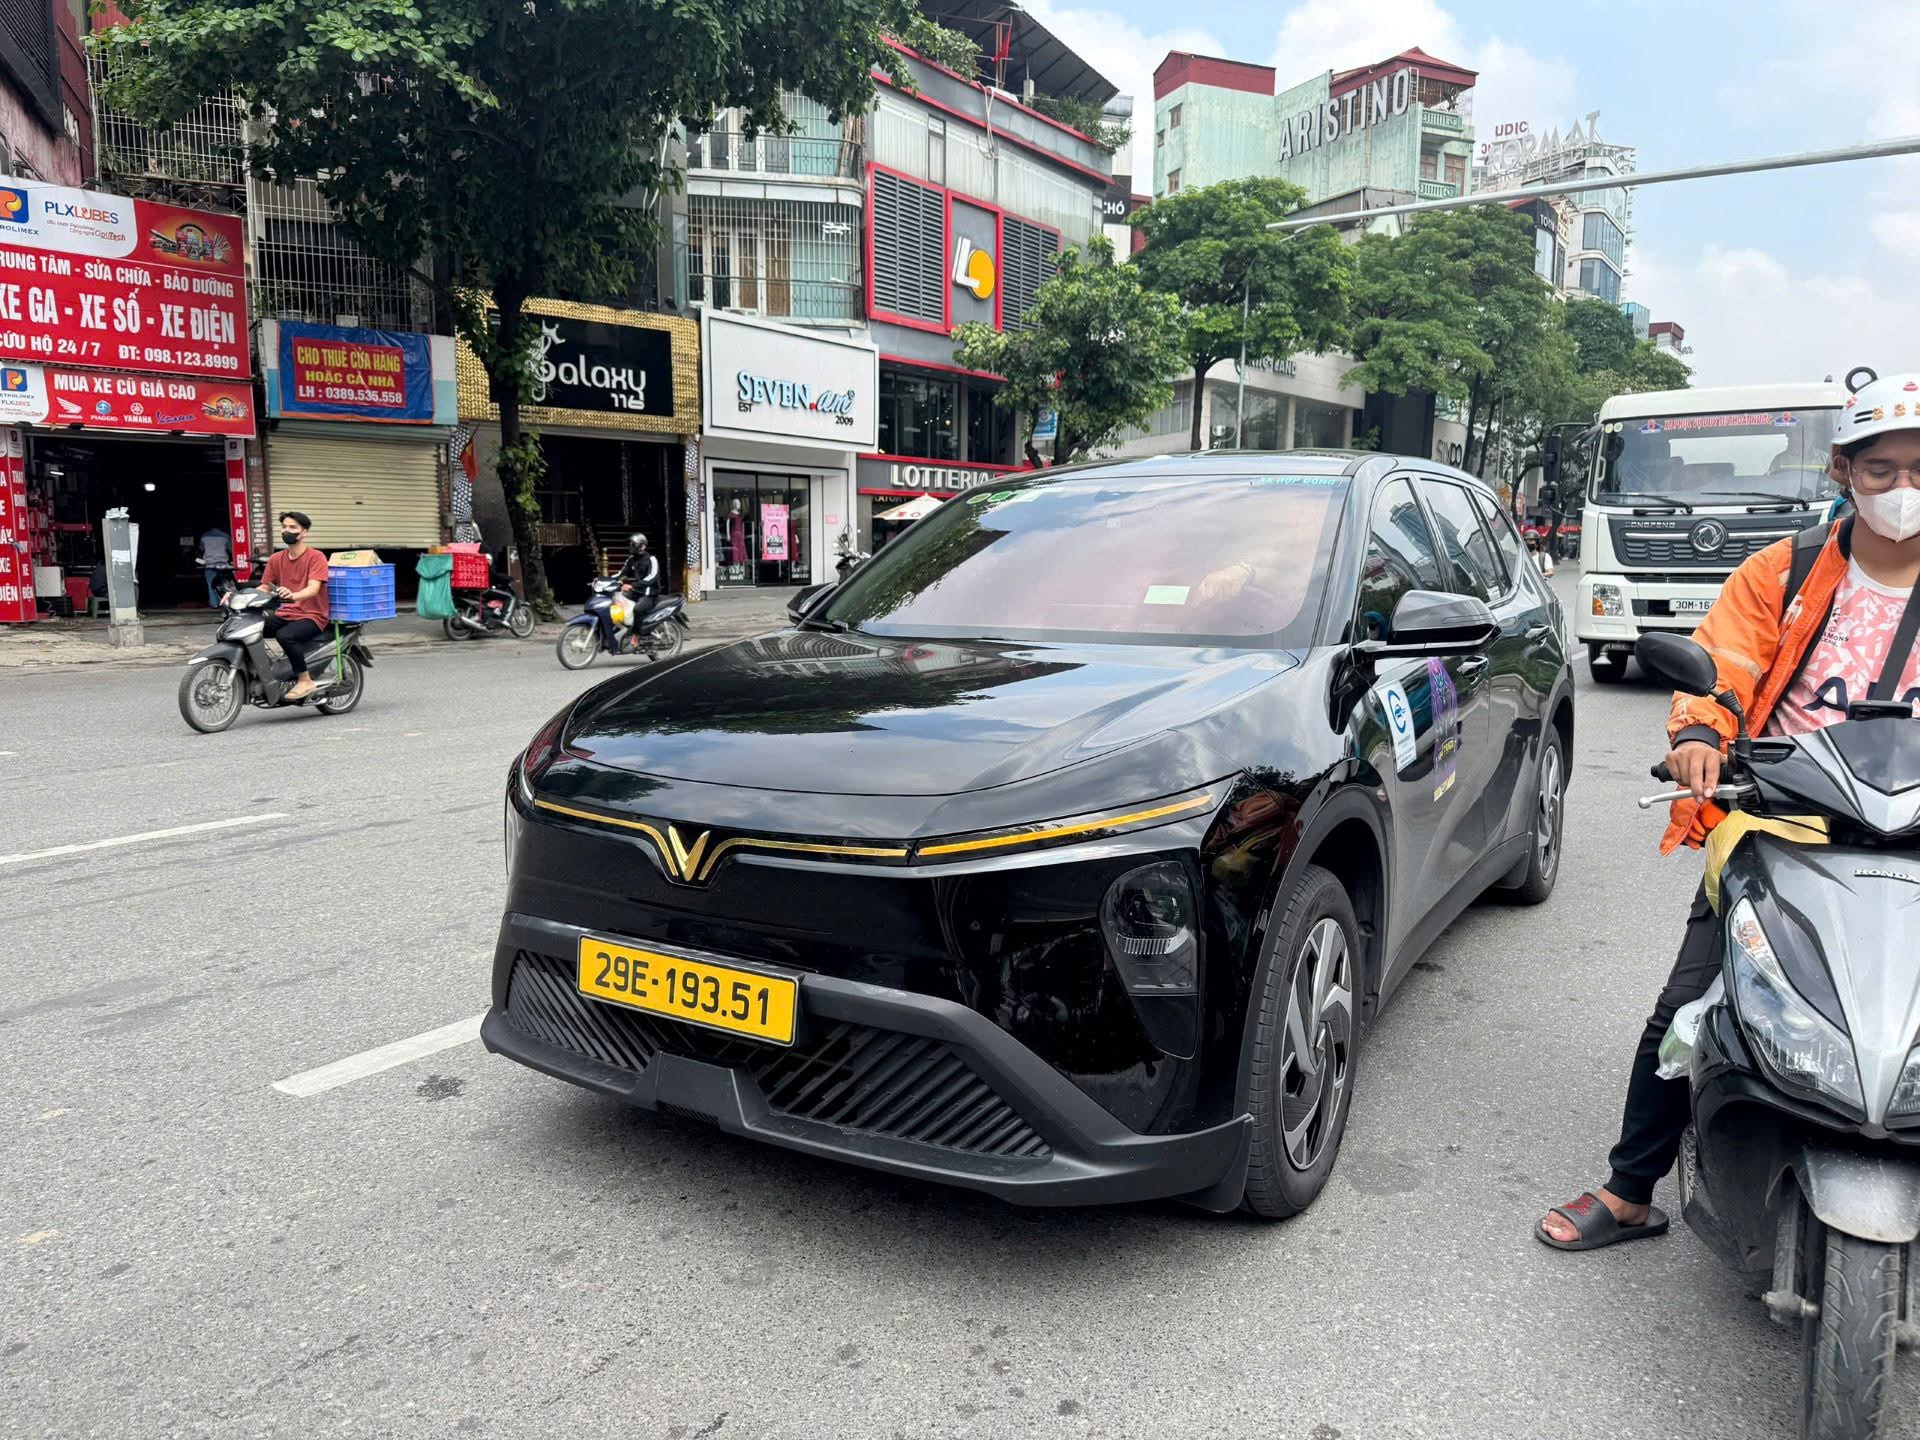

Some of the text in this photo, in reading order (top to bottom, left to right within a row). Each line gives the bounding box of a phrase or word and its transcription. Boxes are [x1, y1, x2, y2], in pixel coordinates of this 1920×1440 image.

[1278, 67, 1412, 162] ARISTINO
[1495, 121, 1529, 137] UDIC
[1103, 199, 1126, 215] HÓ
[39, 254, 71, 276] TÂM
[84, 259, 112, 281] SỬA
[116, 265, 152, 287] CHỮA
[164, 270, 189, 291] BẢO
[192, 277, 234, 298] DƯỠNG
[28, 286, 59, 325] GA
[79, 293, 107, 330] XE
[113, 287, 140, 334] SỐ
[160, 303, 186, 338] XE
[190, 302, 236, 349] ĐIỆN
[31, 335, 53, 355] HỘ
[57, 339, 77, 355] 24
[91, 342, 100, 357] 7
[118, 344, 141, 361] ĐT:
[144, 348, 239, 370] 098.123.8999
[297, 346, 400, 373] CHO THUÊ CỬA HÀNG
[54, 374, 197, 401] MUA XE CŨ GIÁ CAO
[306, 370, 395, 388] HOẶC CẢ NHÀ
[299, 385, 315, 398] LH
[325, 388, 403, 404] 0389.535.558
[611, 392, 645, 410] 116
[738, 402, 753, 413] EST
[90, 414, 118, 422] PIAGGIO
[123, 414, 152, 424] YAMAHA
[835, 415, 854, 426] 2009
[1854, 869, 1920, 884] HONDA
[595, 951, 769, 1026] 29E-193.51
